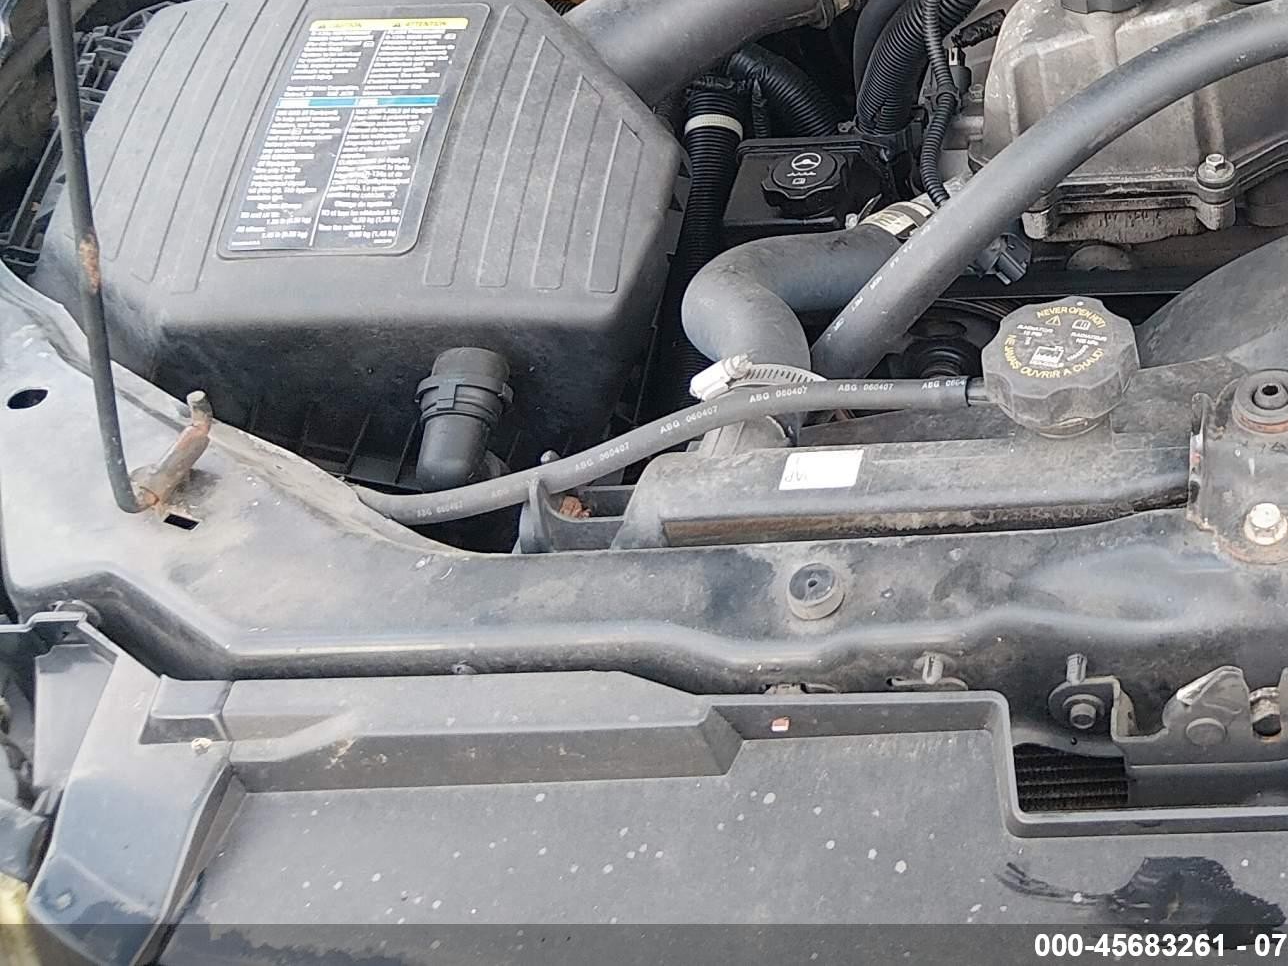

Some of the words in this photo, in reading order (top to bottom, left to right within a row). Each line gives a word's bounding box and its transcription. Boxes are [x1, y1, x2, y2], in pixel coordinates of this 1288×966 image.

[1036, 306, 1068, 318] NEVER
[1068, 306, 1091, 319] OPEN
[1020, 366, 1062, 379] OUVRIR
[837, 383, 858, 392] ABG
[921, 380, 941, 390] ABG
[749, 391, 771, 404] ABG
[660, 419, 681, 435] ABG
